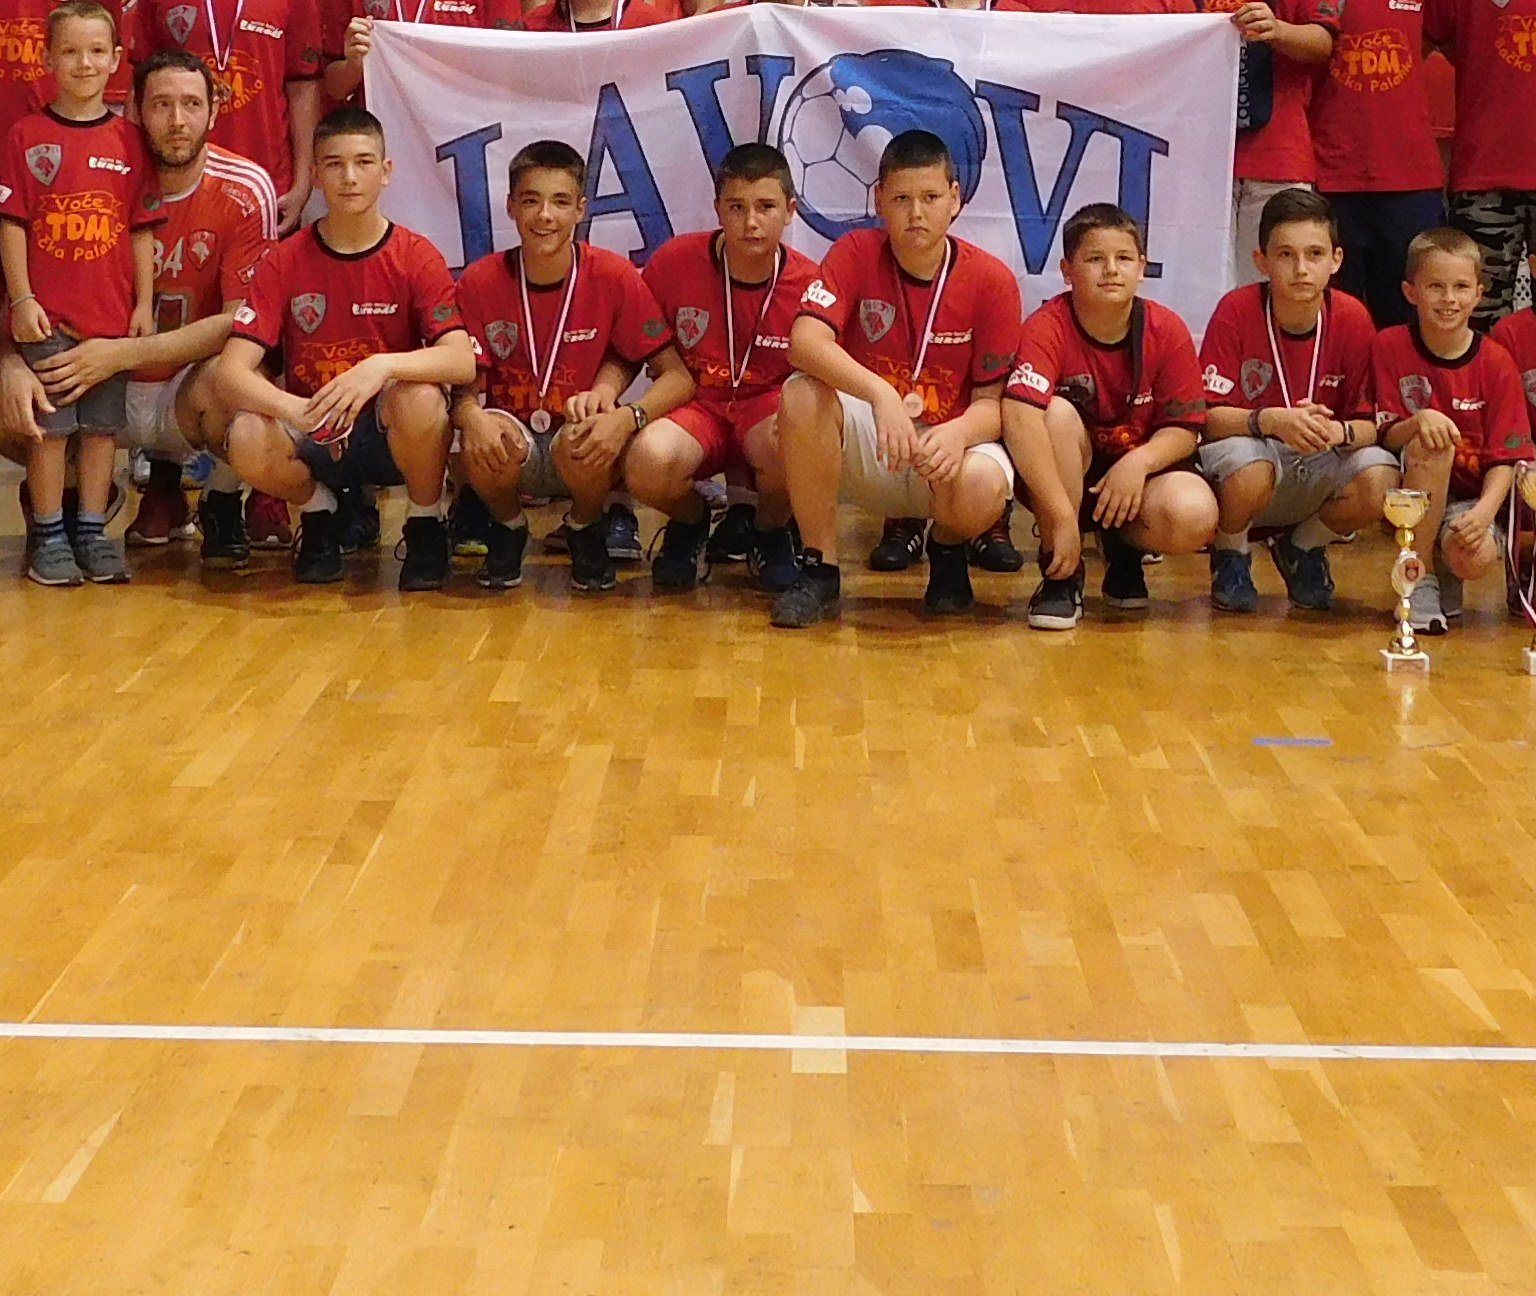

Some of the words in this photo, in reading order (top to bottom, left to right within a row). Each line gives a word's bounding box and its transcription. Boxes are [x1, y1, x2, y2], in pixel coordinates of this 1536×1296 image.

[13, 66, 46, 81] Pala
[1343, 50, 1400, 75] TDM
[46, 213, 110, 241] TDM
